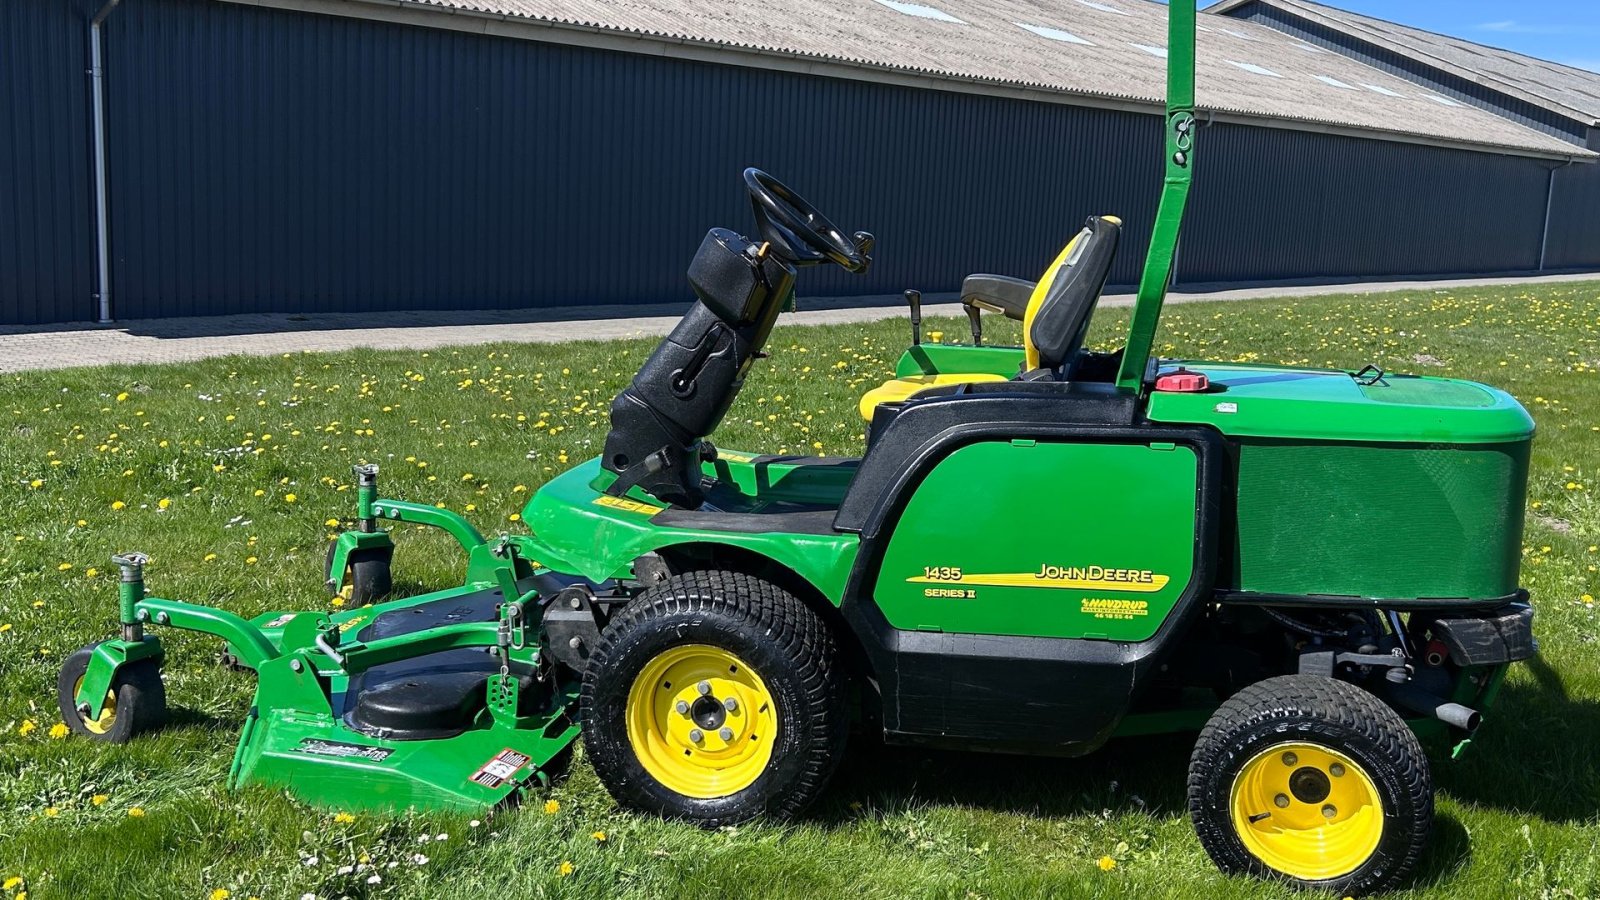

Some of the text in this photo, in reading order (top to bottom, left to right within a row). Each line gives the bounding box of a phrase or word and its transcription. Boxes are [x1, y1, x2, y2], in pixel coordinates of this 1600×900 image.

[924, 566, 962, 580] 1435
[1035, 563, 1153, 583] JOHN DEERE
[924, 588, 976, 598] SERIES II
[1088, 598, 1148, 610] HAVDRUP
